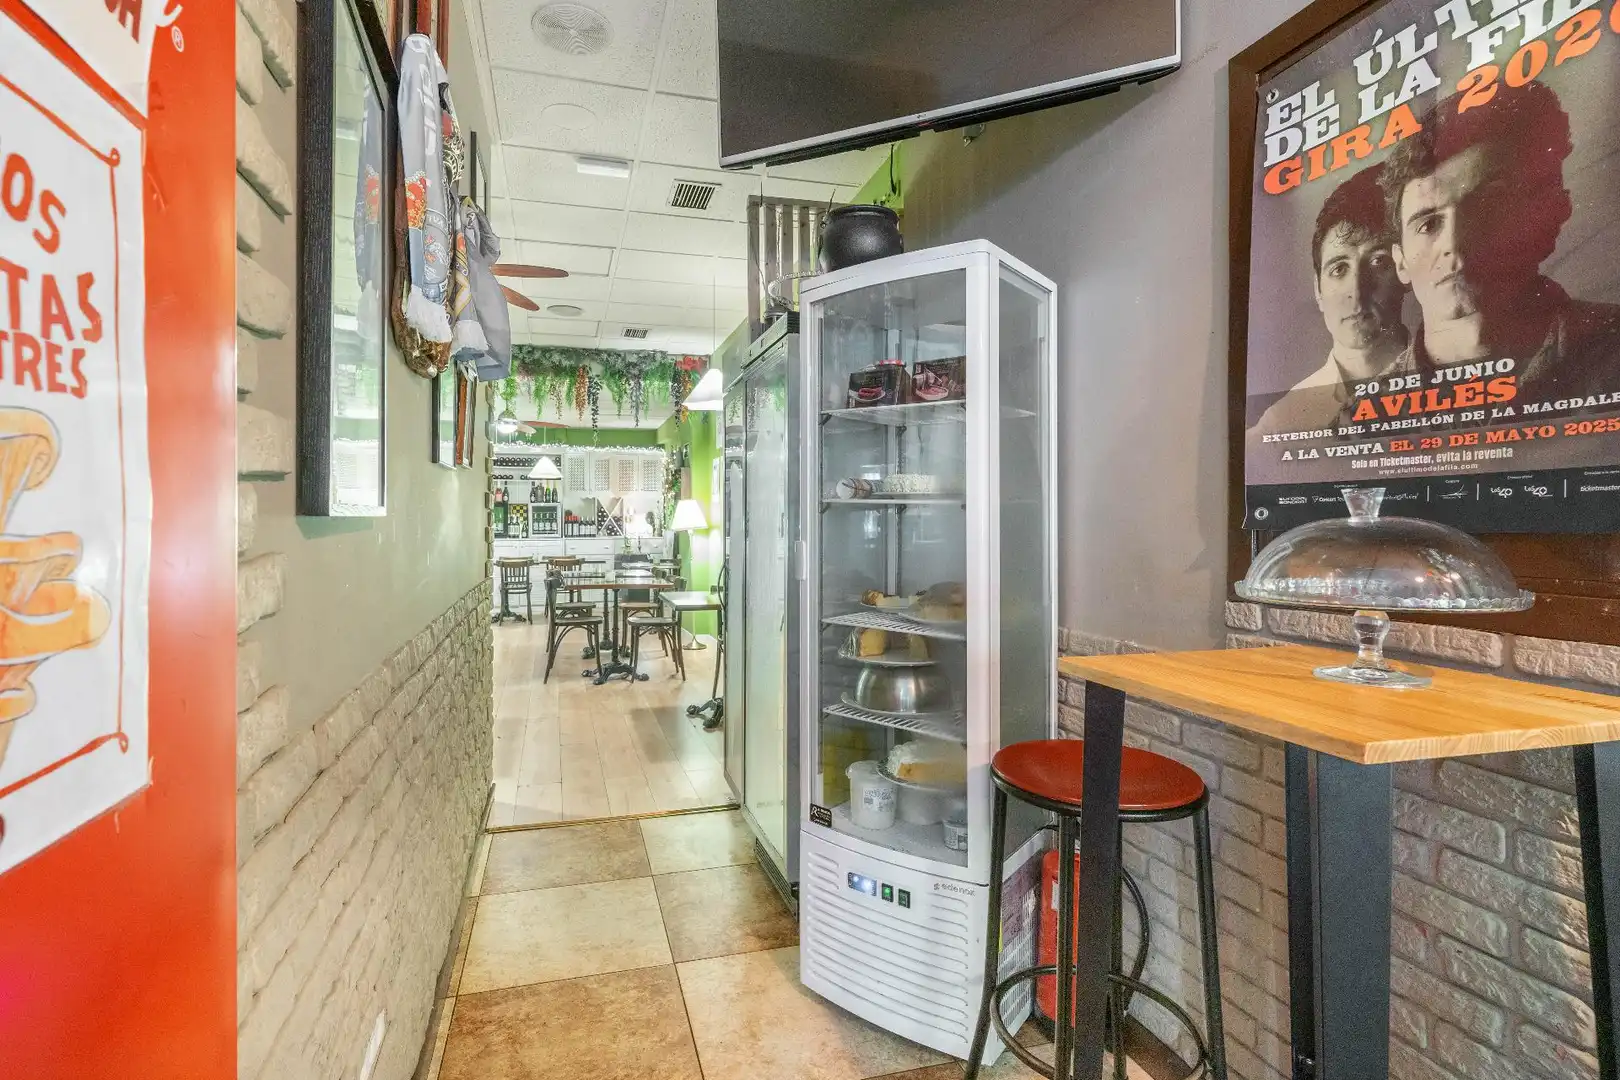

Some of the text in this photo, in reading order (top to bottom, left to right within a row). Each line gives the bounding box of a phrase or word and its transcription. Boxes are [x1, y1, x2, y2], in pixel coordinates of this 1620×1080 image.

[1264, 104, 1340, 168] DE
[1357, 57, 1441, 125] LA
[1265, 81, 1336, 136] EL
[1263, 104, 1423, 195] GIRA
[1, 152, 67, 255] OS
[1352, 374, 1517, 422] AVILÉS
[1354, 358, 1515, 397] 20 DE JUNIO
[1262, 428, 1333, 443] EXTERIOR
[1337, 425, 1366, 436] DEL
[1370, 412, 1454, 432] PABELLÓN
[1461, 410, 1485, 422] DE
[1491, 407, 1516, 418] LA
[1281, 417, 1620, 461] A LA VENTA EL 29 DE MAYO 2025
[1351, 447, 1513, 469] Solo en Ticketmaster, evita la reventa
